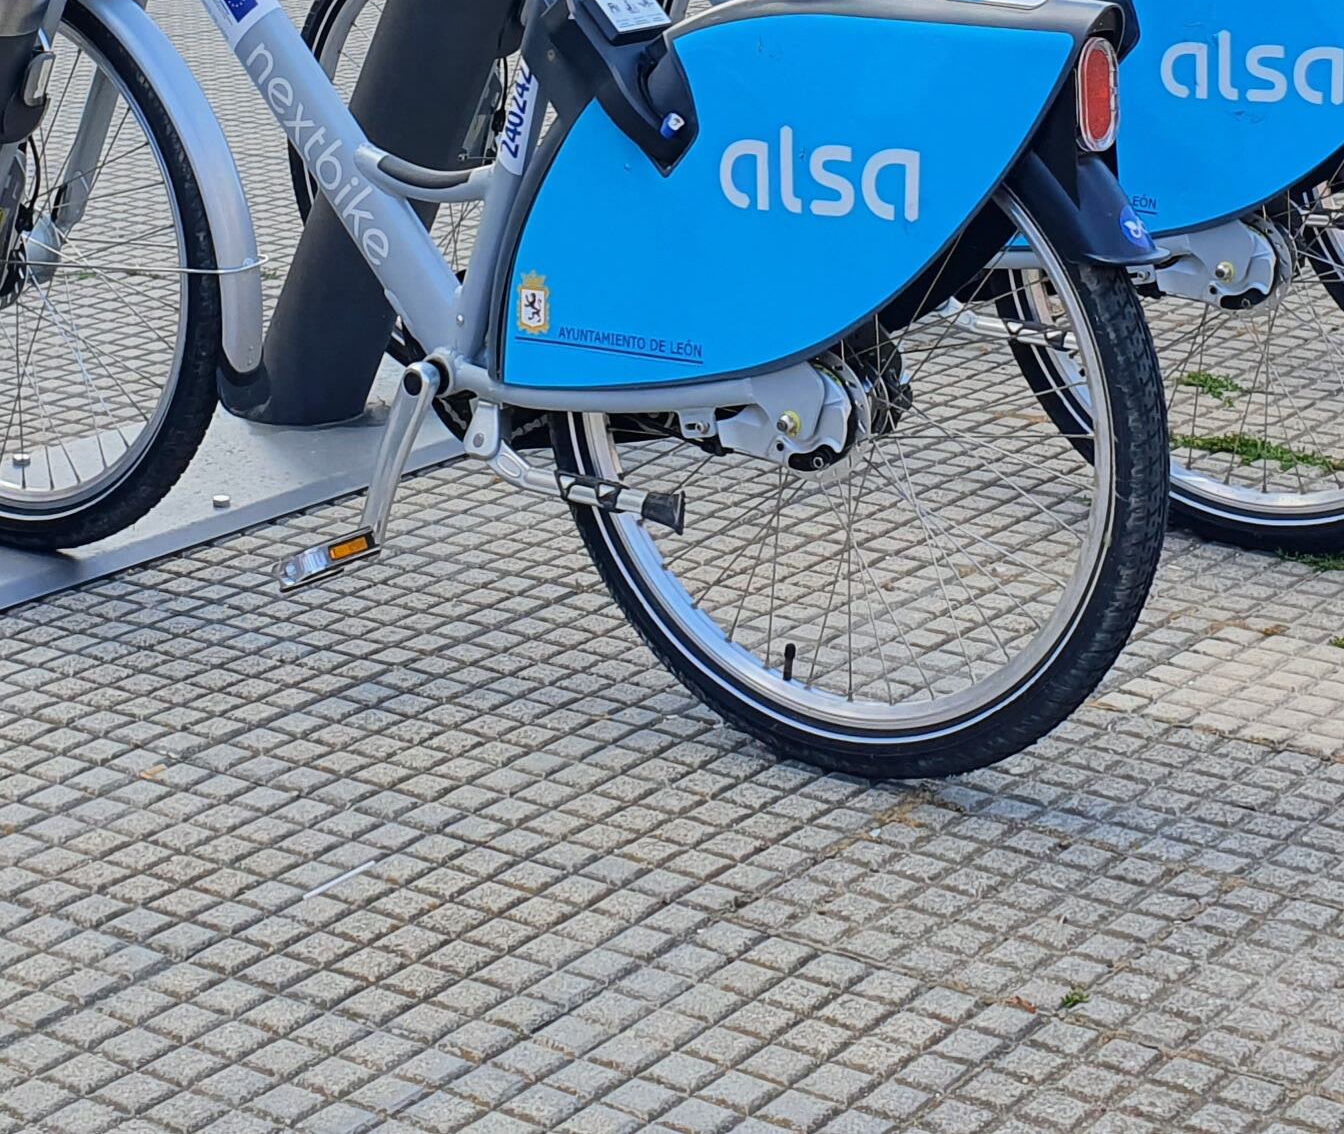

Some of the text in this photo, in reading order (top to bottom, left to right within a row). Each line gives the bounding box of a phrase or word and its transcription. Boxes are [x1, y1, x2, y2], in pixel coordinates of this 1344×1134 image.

[1160, 29, 1344, 106] alsa
[246, 42, 389, 265] nextbike
[719, 124, 921, 223] alsa
[1131, 194, 1157, 209] EÓN
[558, 327, 703, 357] AYUNTAMIENTO DE LEÓN
